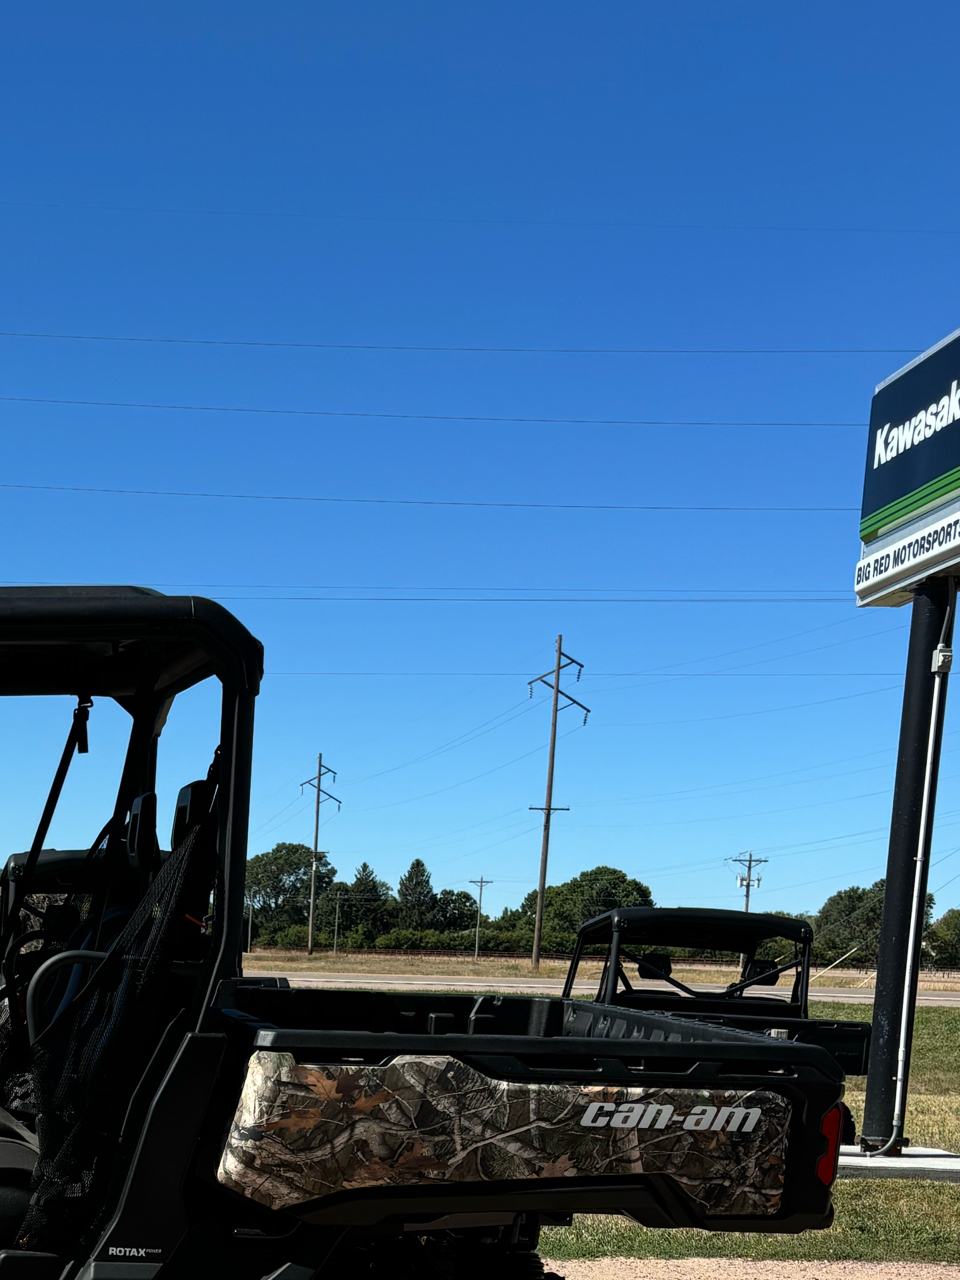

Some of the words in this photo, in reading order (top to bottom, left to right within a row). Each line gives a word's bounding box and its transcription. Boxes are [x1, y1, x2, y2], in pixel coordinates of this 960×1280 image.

[856, 562, 871, 586] BIG
[872, 553, 890, 578] RED
[580, 1102, 762, 1133] can-am
[108, 1246, 146, 1257] ROTAX
